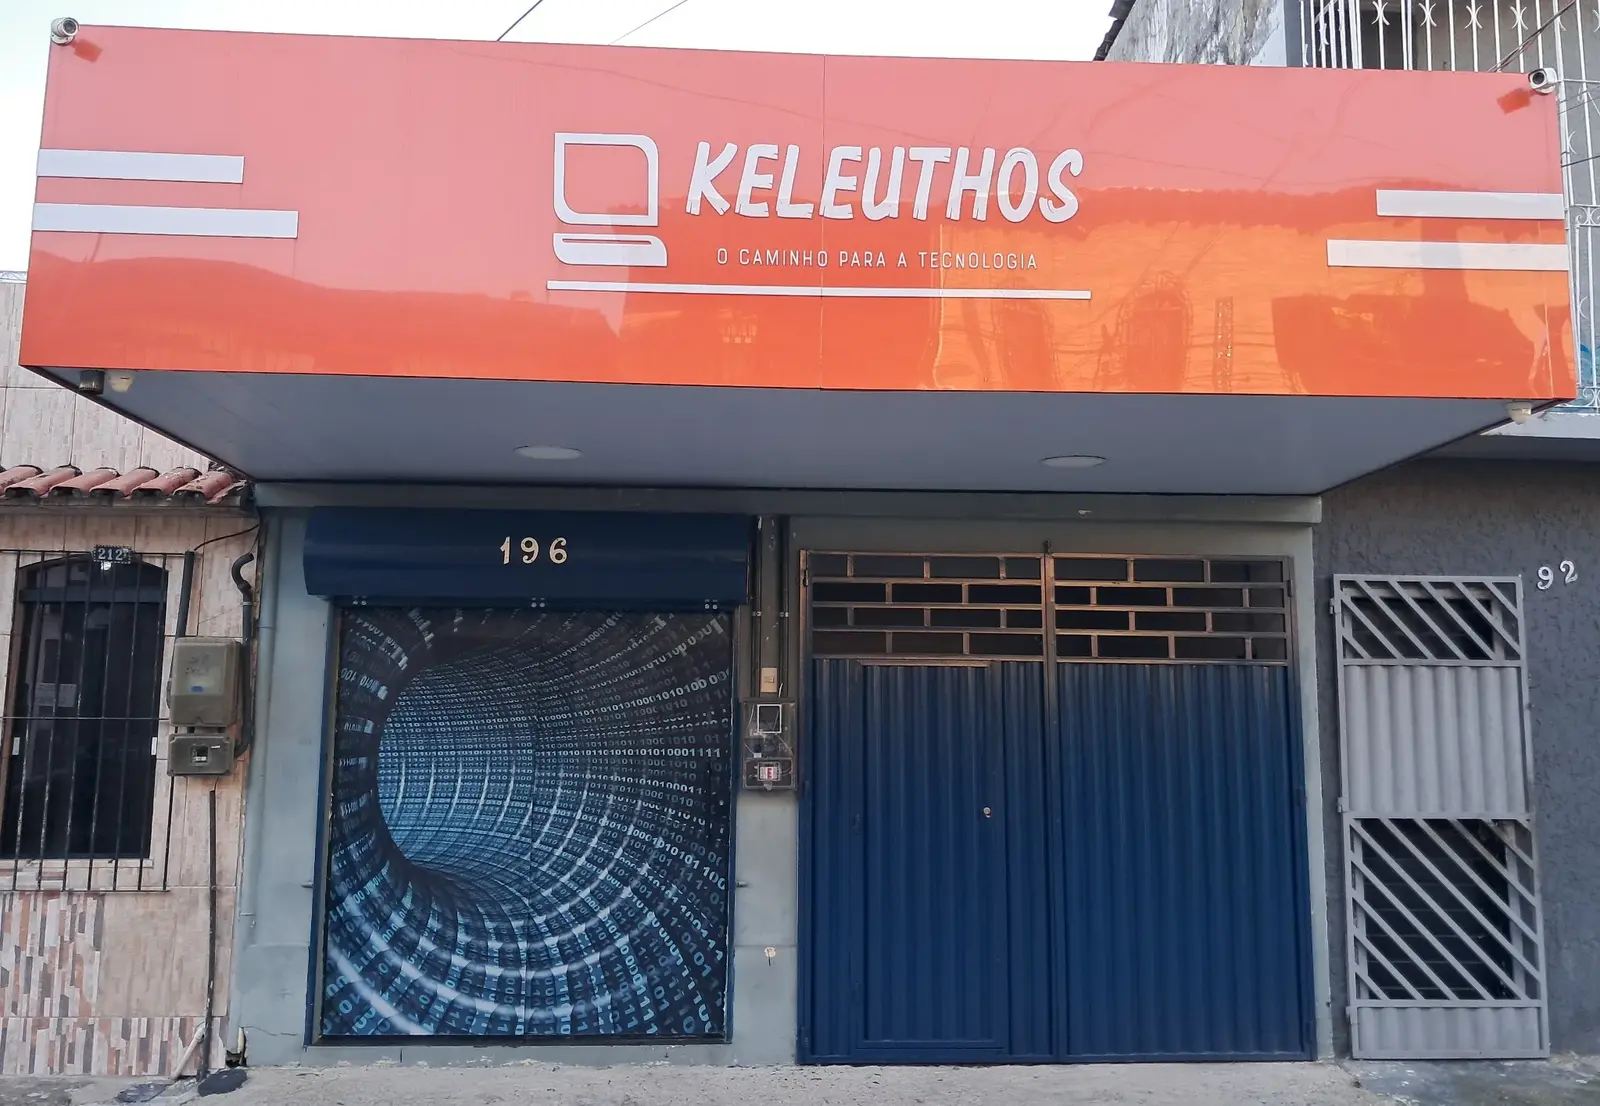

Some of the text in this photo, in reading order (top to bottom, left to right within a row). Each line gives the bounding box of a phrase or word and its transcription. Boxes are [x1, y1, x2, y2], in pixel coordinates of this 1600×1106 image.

[686, 141, 1084, 223] KELEUTHOS
[717, 247, 1038, 269] O CAMINHO PARA A TECNOLOGIA
[500, 537, 568, 564] 196
[1537, 560, 1578, 590] 92
